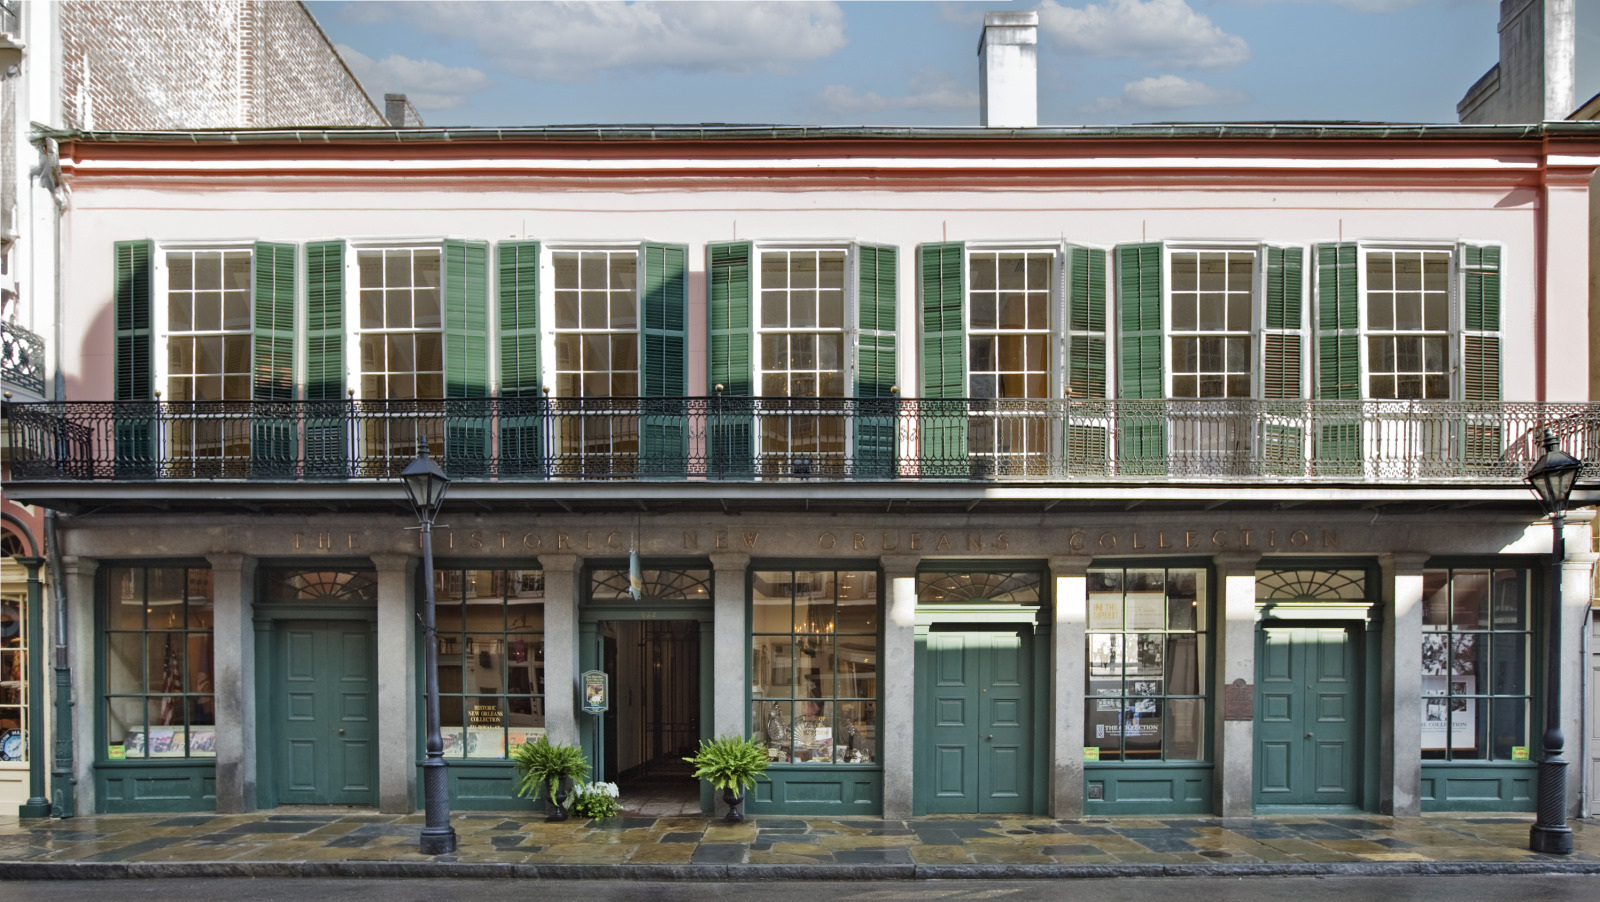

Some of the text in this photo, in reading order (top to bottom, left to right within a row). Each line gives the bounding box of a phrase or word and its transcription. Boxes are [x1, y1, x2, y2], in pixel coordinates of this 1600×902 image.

[293, 531, 361, 549] THE
[682, 531, 761, 549] NEW
[818, 531, 1011, 550] ORLEANS
[1069, 529, 1340, 550] COLLECTION
